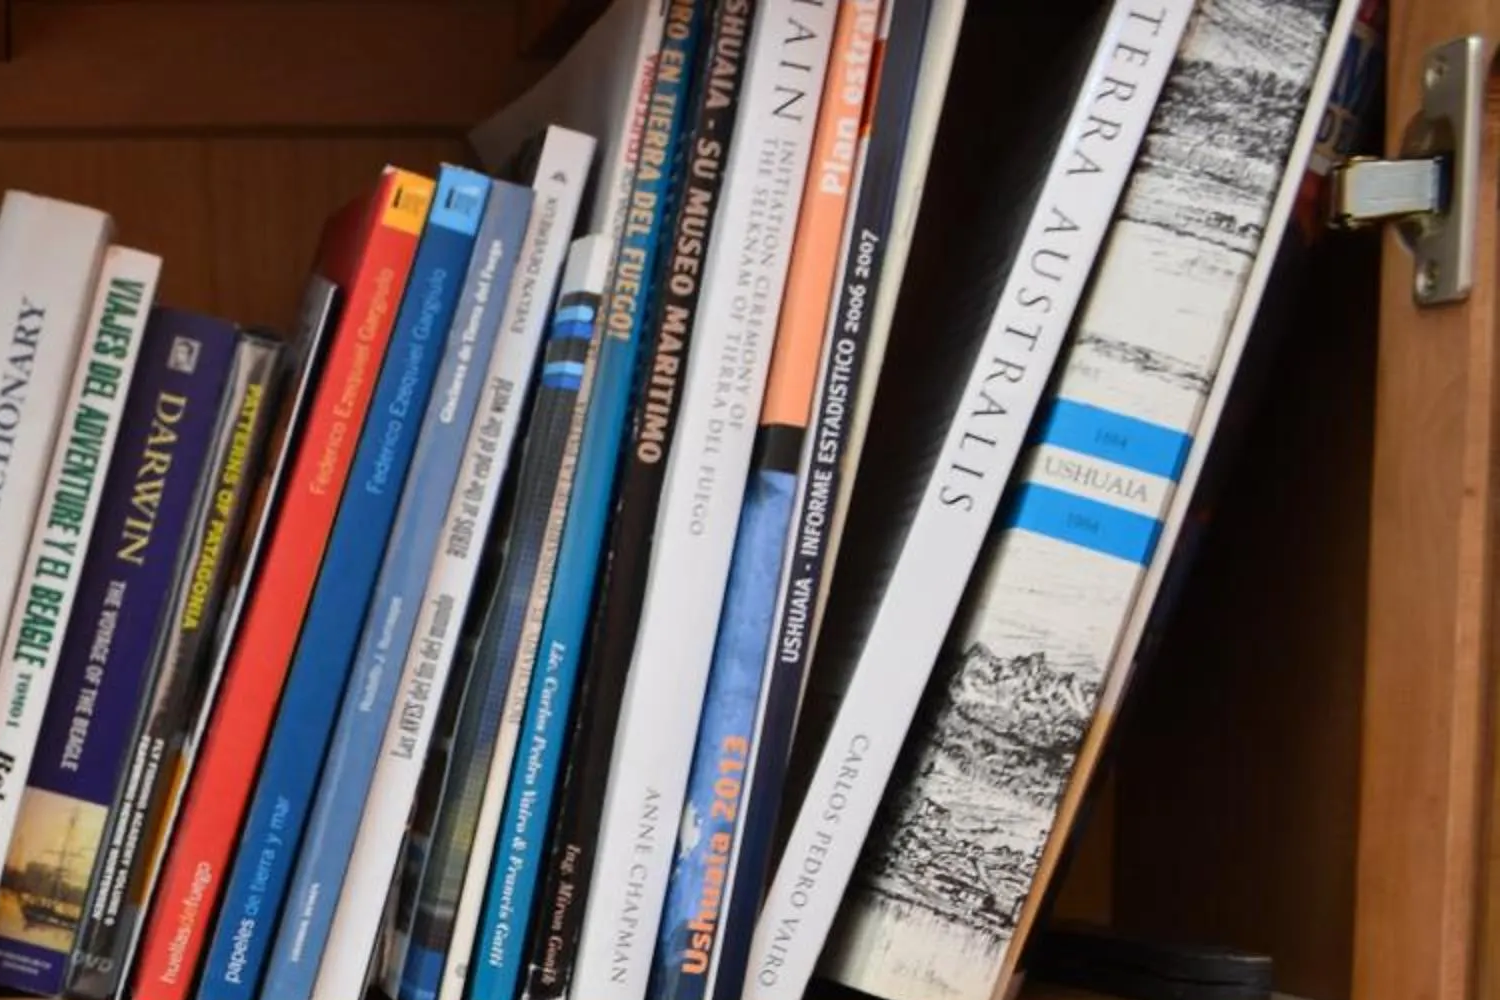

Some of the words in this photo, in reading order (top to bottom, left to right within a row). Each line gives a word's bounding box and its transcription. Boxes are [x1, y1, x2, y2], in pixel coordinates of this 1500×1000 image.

[1063, 0, 1168, 189] TERRA
[756, 137, 779, 176] THE
[735, 185, 769, 287] SELKNAM
[757, 138, 798, 266] INITIATION
[853, 228, 881, 279] 2007
[91, 274, 144, 360] VIAJES
[728, 294, 749, 323] OF
[733, 275, 772, 394] CEREMONY
[843, 282, 868, 333] 2006
[79, 359, 121, 404] DEL
[712, 333, 742, 410] TIERRA
[937, 206, 1083, 516] AUSTRALIS
[221, 381, 263, 485] PATTERNS
[727, 402, 746, 431] OF
[815, 338, 858, 463] ESTADISTICO
[47, 401, 110, 536] ADVENTURE
[701, 417, 725, 456] DEL
[113, 390, 189, 566] DARWIN
[212, 486, 235, 517] OF
[684, 464, 718, 537] FUEGO
[798, 467, 834, 557] INFORME
[1046, 455, 1145, 502] USHUAIA
[34, 555, 70, 583] EL
[40, 534, 76, 559] Y
[181, 517, 226, 633] PATAGONIA
[12, 583, 64, 668] BEAGLE
[103, 578, 126, 608] THE
[779, 576, 814, 664] USHUAIA
[88, 607, 118, 664] VOYAGE
[74, 687, 97, 715] THE
[82, 663, 103, 685] OF
[58, 715, 89, 772] BEAGLE
[270, 795, 290, 829] mar
[820, 731, 871, 825] CARLOS
[265, 833, 283, 848] y
[635, 787, 661, 853] ANNE
[679, 828, 731, 975] Ushuaia
[708, 732, 749, 822] 2013
[248, 846, 275, 893] tierra
[786, 829, 833, 911] PEDRO
[241, 894, 262, 916] de
[609, 863, 648, 985] CHAPMAN
[221, 916, 257, 984] papeles
[755, 913, 798, 989] VAIRO
